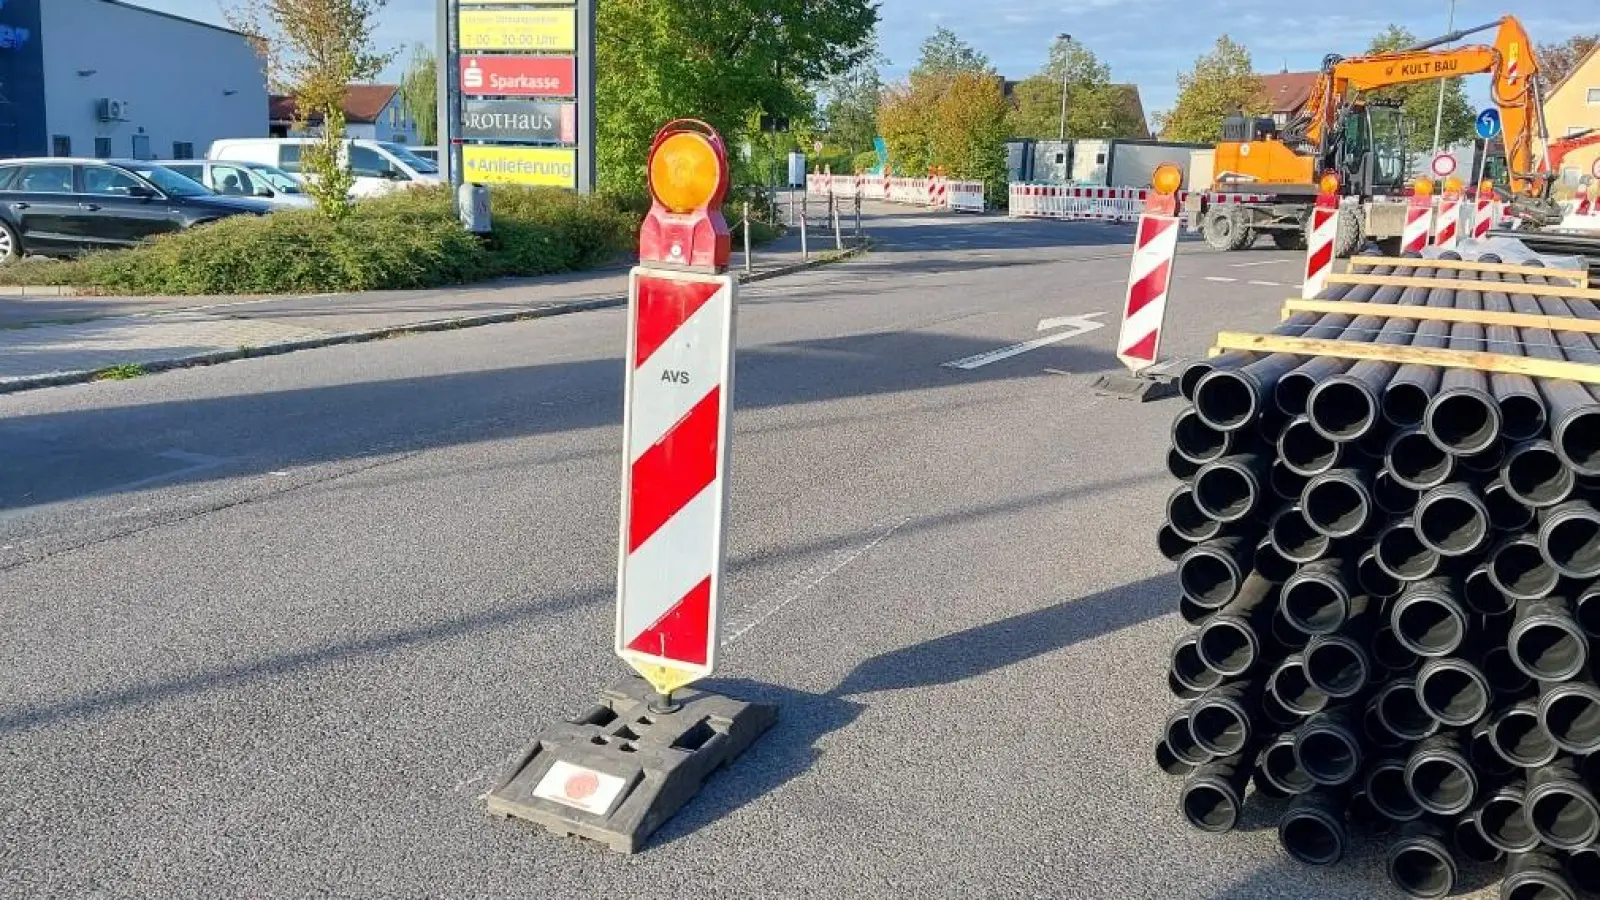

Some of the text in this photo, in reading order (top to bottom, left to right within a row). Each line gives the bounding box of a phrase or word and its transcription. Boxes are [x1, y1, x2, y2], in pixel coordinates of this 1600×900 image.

[1402, 60, 1457, 76] KULT BAU
[489, 72, 560, 90] Sparkasse
[478, 156, 571, 178] Anlieferung
[661, 369, 690, 384] AVS
